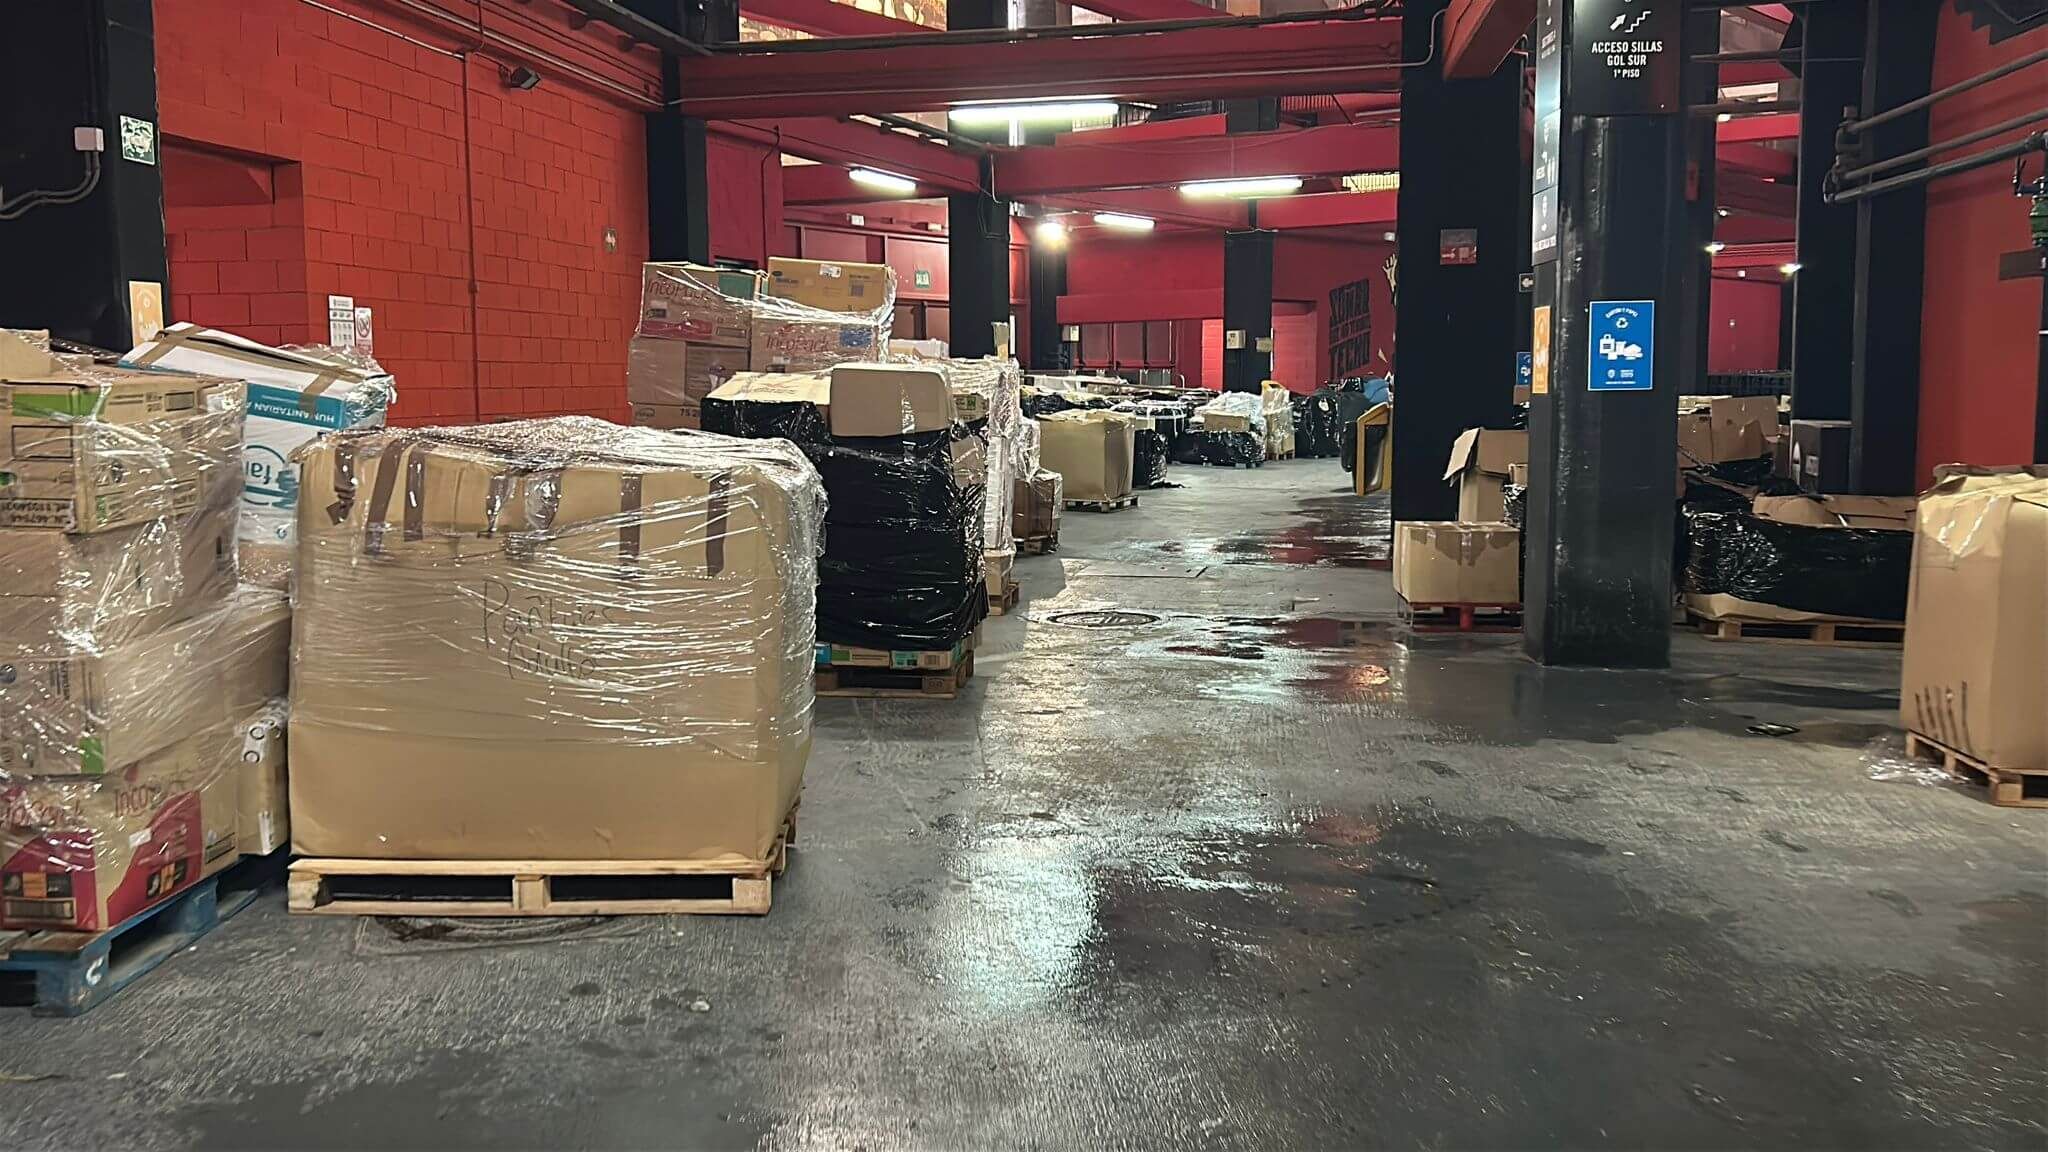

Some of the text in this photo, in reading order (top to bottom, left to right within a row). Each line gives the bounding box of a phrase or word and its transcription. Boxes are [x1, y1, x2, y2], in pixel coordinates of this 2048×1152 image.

[1591, 41, 1663, 54] ACCESO SILLAS
[1607, 54, 1647, 66] GOL SUR
[1622, 68, 1640, 78] PISO
